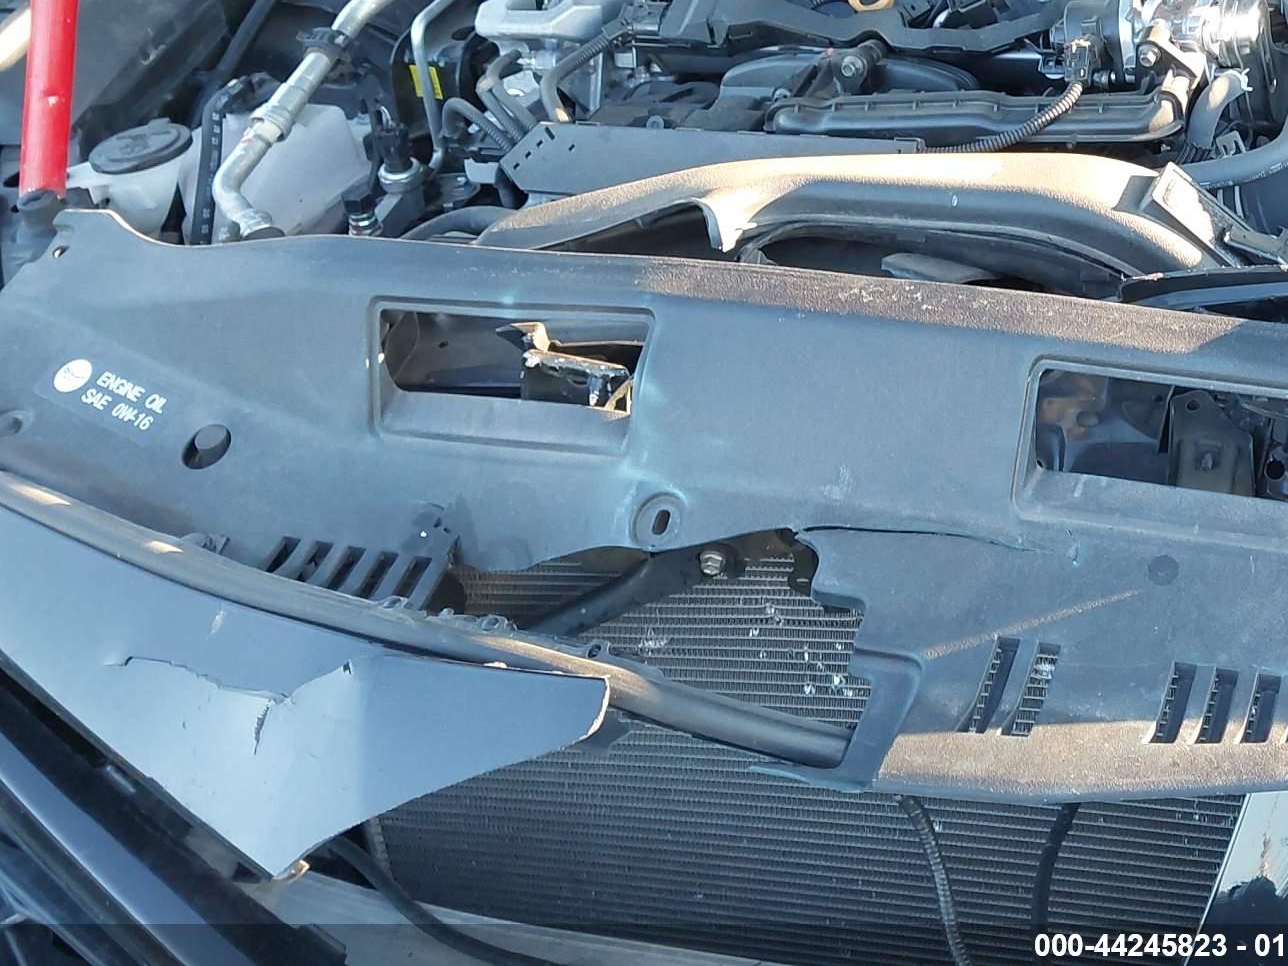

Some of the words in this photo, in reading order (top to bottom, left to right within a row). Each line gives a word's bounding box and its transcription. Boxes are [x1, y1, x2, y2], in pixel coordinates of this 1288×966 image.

[81, 389, 112, 410] SAE
[112, 403, 153, 430] 0W-16
[97, 372, 145, 402] ENGINE
[147, 393, 168, 414] OIL
